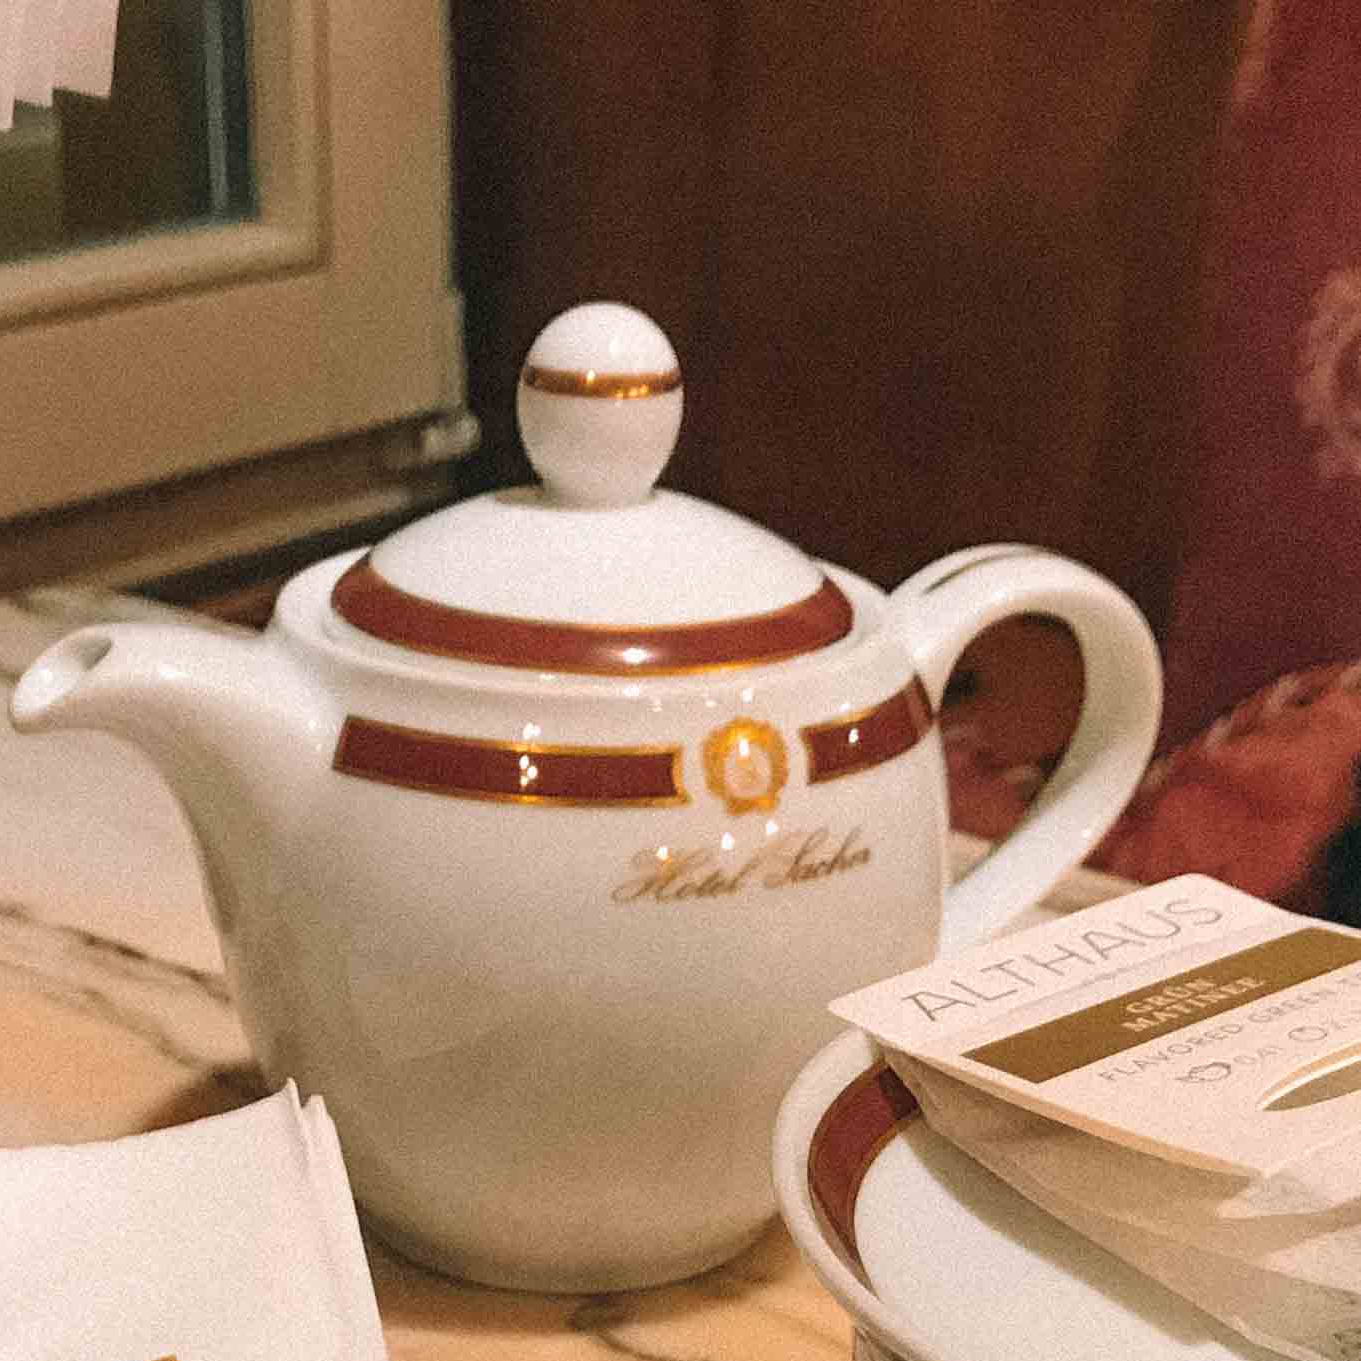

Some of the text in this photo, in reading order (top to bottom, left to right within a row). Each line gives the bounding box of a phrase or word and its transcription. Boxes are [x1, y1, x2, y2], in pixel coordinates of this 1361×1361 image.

[612, 847, 760, 902] Hotel
[902, 897, 1223, 1022] ALTHAUS
[1098, 1023, 1243, 1081] FLAVORED
